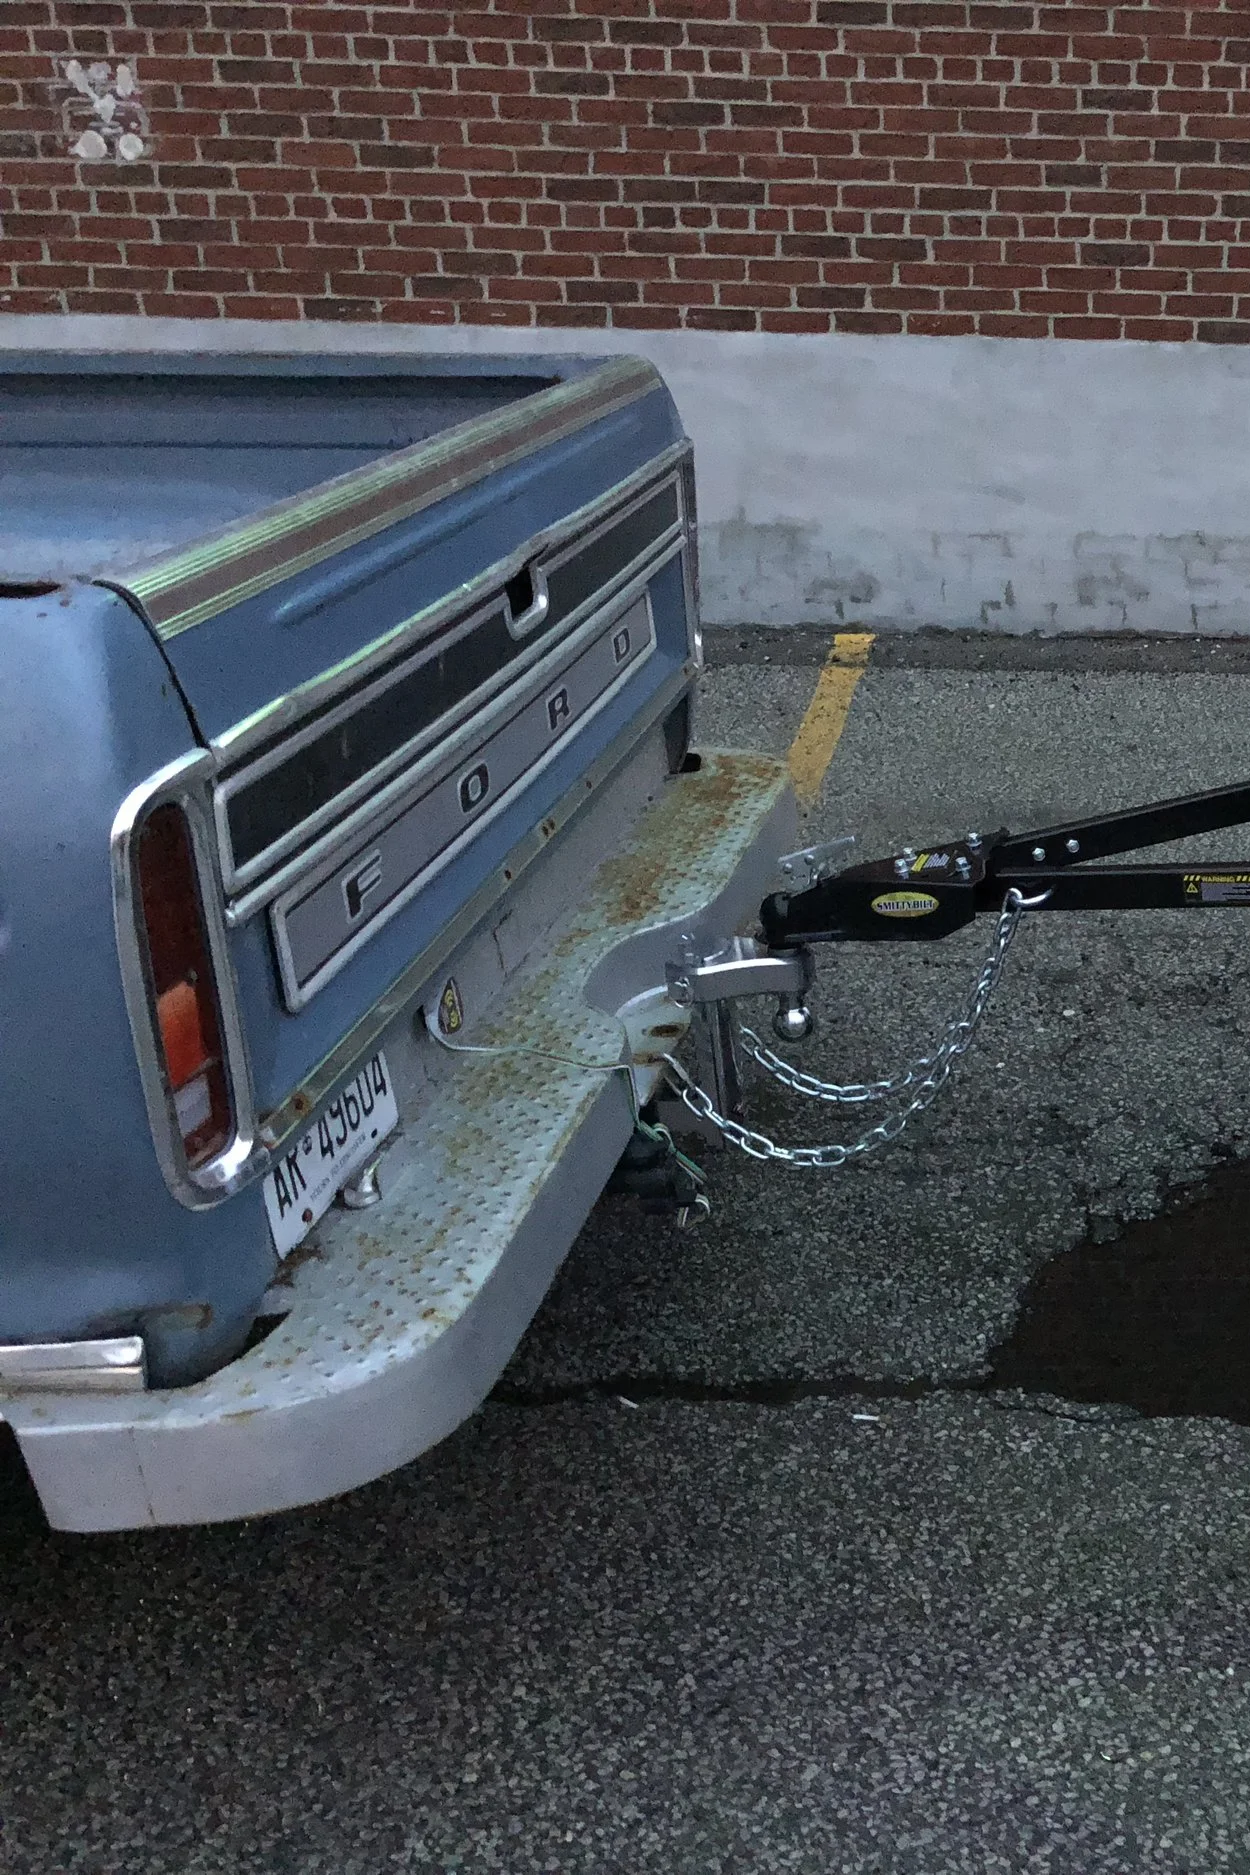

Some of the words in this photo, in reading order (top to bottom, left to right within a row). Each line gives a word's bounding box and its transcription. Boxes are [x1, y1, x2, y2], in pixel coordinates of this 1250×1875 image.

[342, 627, 631, 924] FORD
[1200, 875, 1236, 884] WARNING
[876, 899, 934, 912] SMITTYBILT
